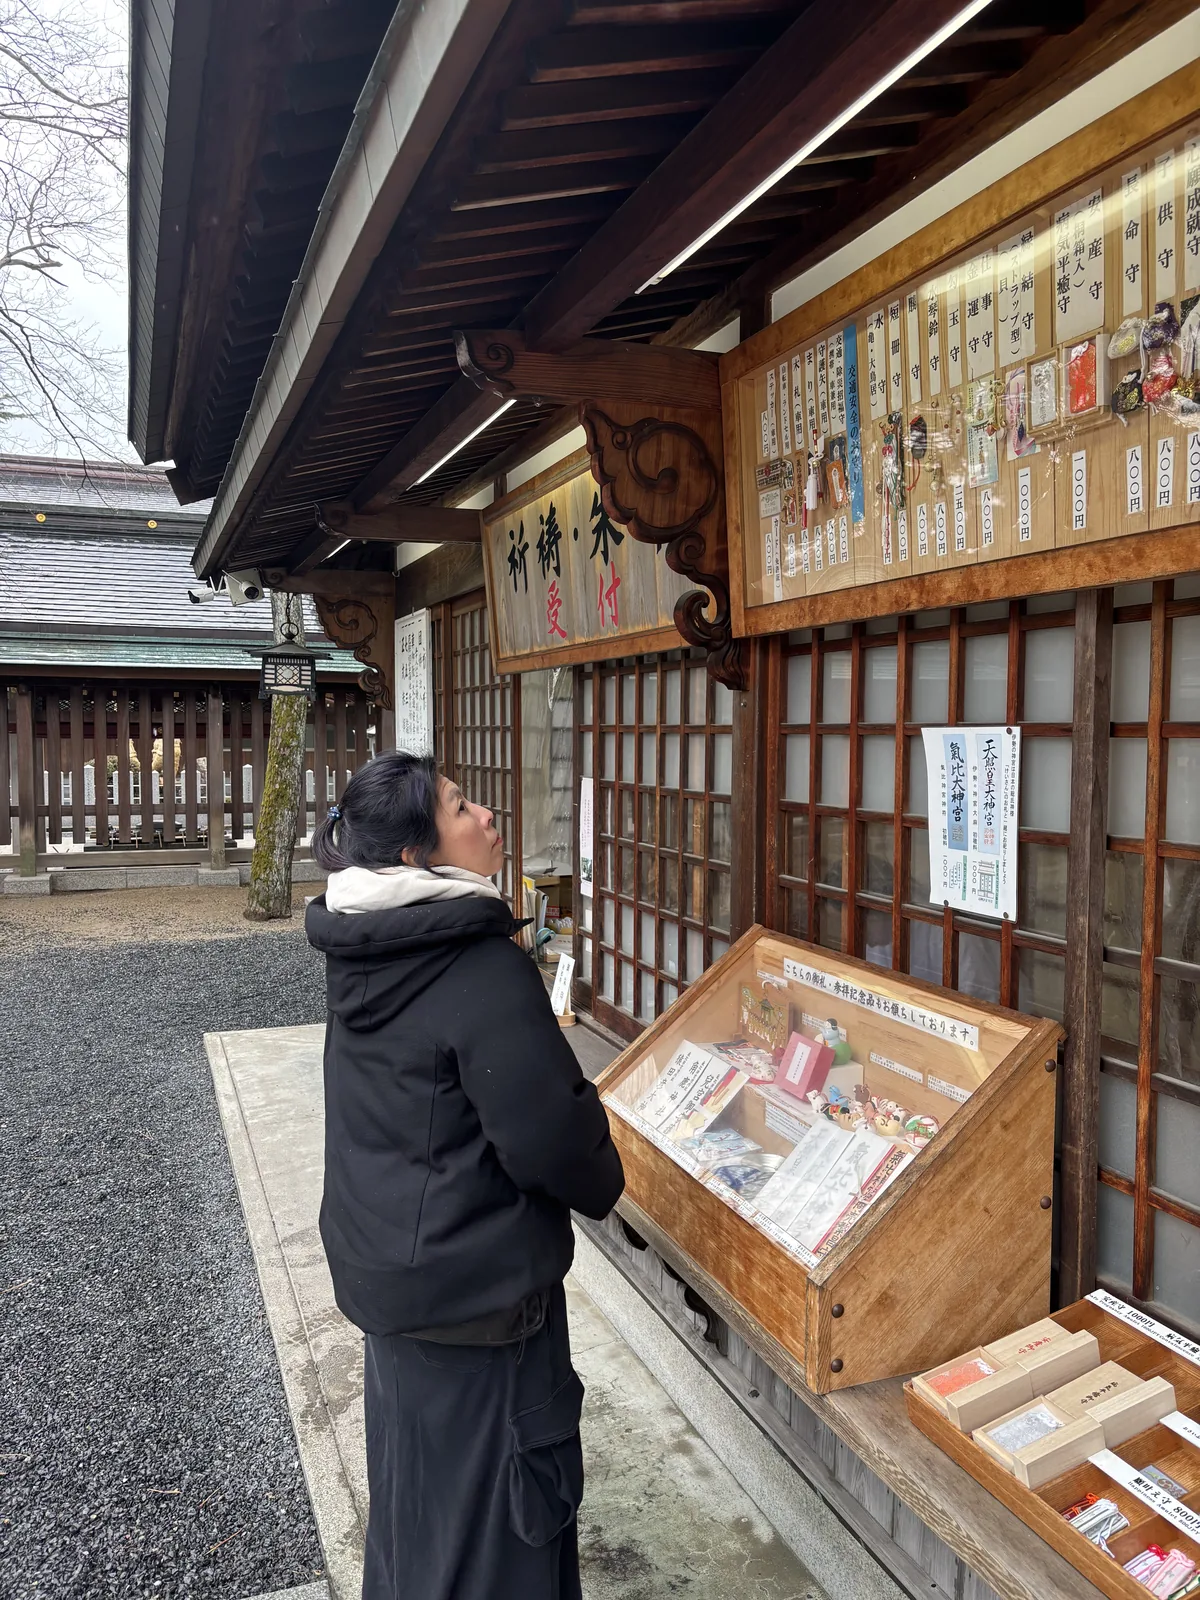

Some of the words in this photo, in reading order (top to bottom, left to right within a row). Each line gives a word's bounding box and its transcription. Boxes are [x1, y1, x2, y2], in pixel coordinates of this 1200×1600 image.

[1088, 195, 1102, 300] 安産守
[1124, 174, 1140, 283] 長命守
[1157, 156, 1174, 269] 子供守
[1056, 212, 1070, 314] 病気平癒守
[967, 262, 980, 354] 金運守
[981, 254, 993, 348] 仕事守
[889, 303, 902, 388] 短冊守
[806, 352, 816, 430] まり（車用
[848, 364, 860, 485] 交通安全のお守り
[1020, 473, 1030, 540] 一〇〇〇円
[1074, 456, 1084, 528] 一〇〇〇円
[1129, 449, 1140, 512] 八〇〇円
[1159, 440, 1171, 506] 八〇〇円
[507, 490, 662, 595] 祈祷・朱
[827, 520, 836, 564] 八〇〇円
[840, 517, 848, 563] 八〇〇円
[899, 512, 907, 560] 八〇〇円
[919, 506, 927, 555] 八〇〇円
[938, 504, 946, 555] 八〇〇円
[983, 491, 992, 544] 八〇〇円
[546, 560, 622, 639] 受付
[950, 742, 966, 822] 氣比大神宮
[982, 739, 998, 826] 天照皇大神宮
[1103, 1295, 1126, 1310] 安産守
[1127, 1310, 1156, 1328] 1000円
[1165, 1332, 1200, 1356] 病気平癒
[1156, 1503, 1178, 1519] Amulet
